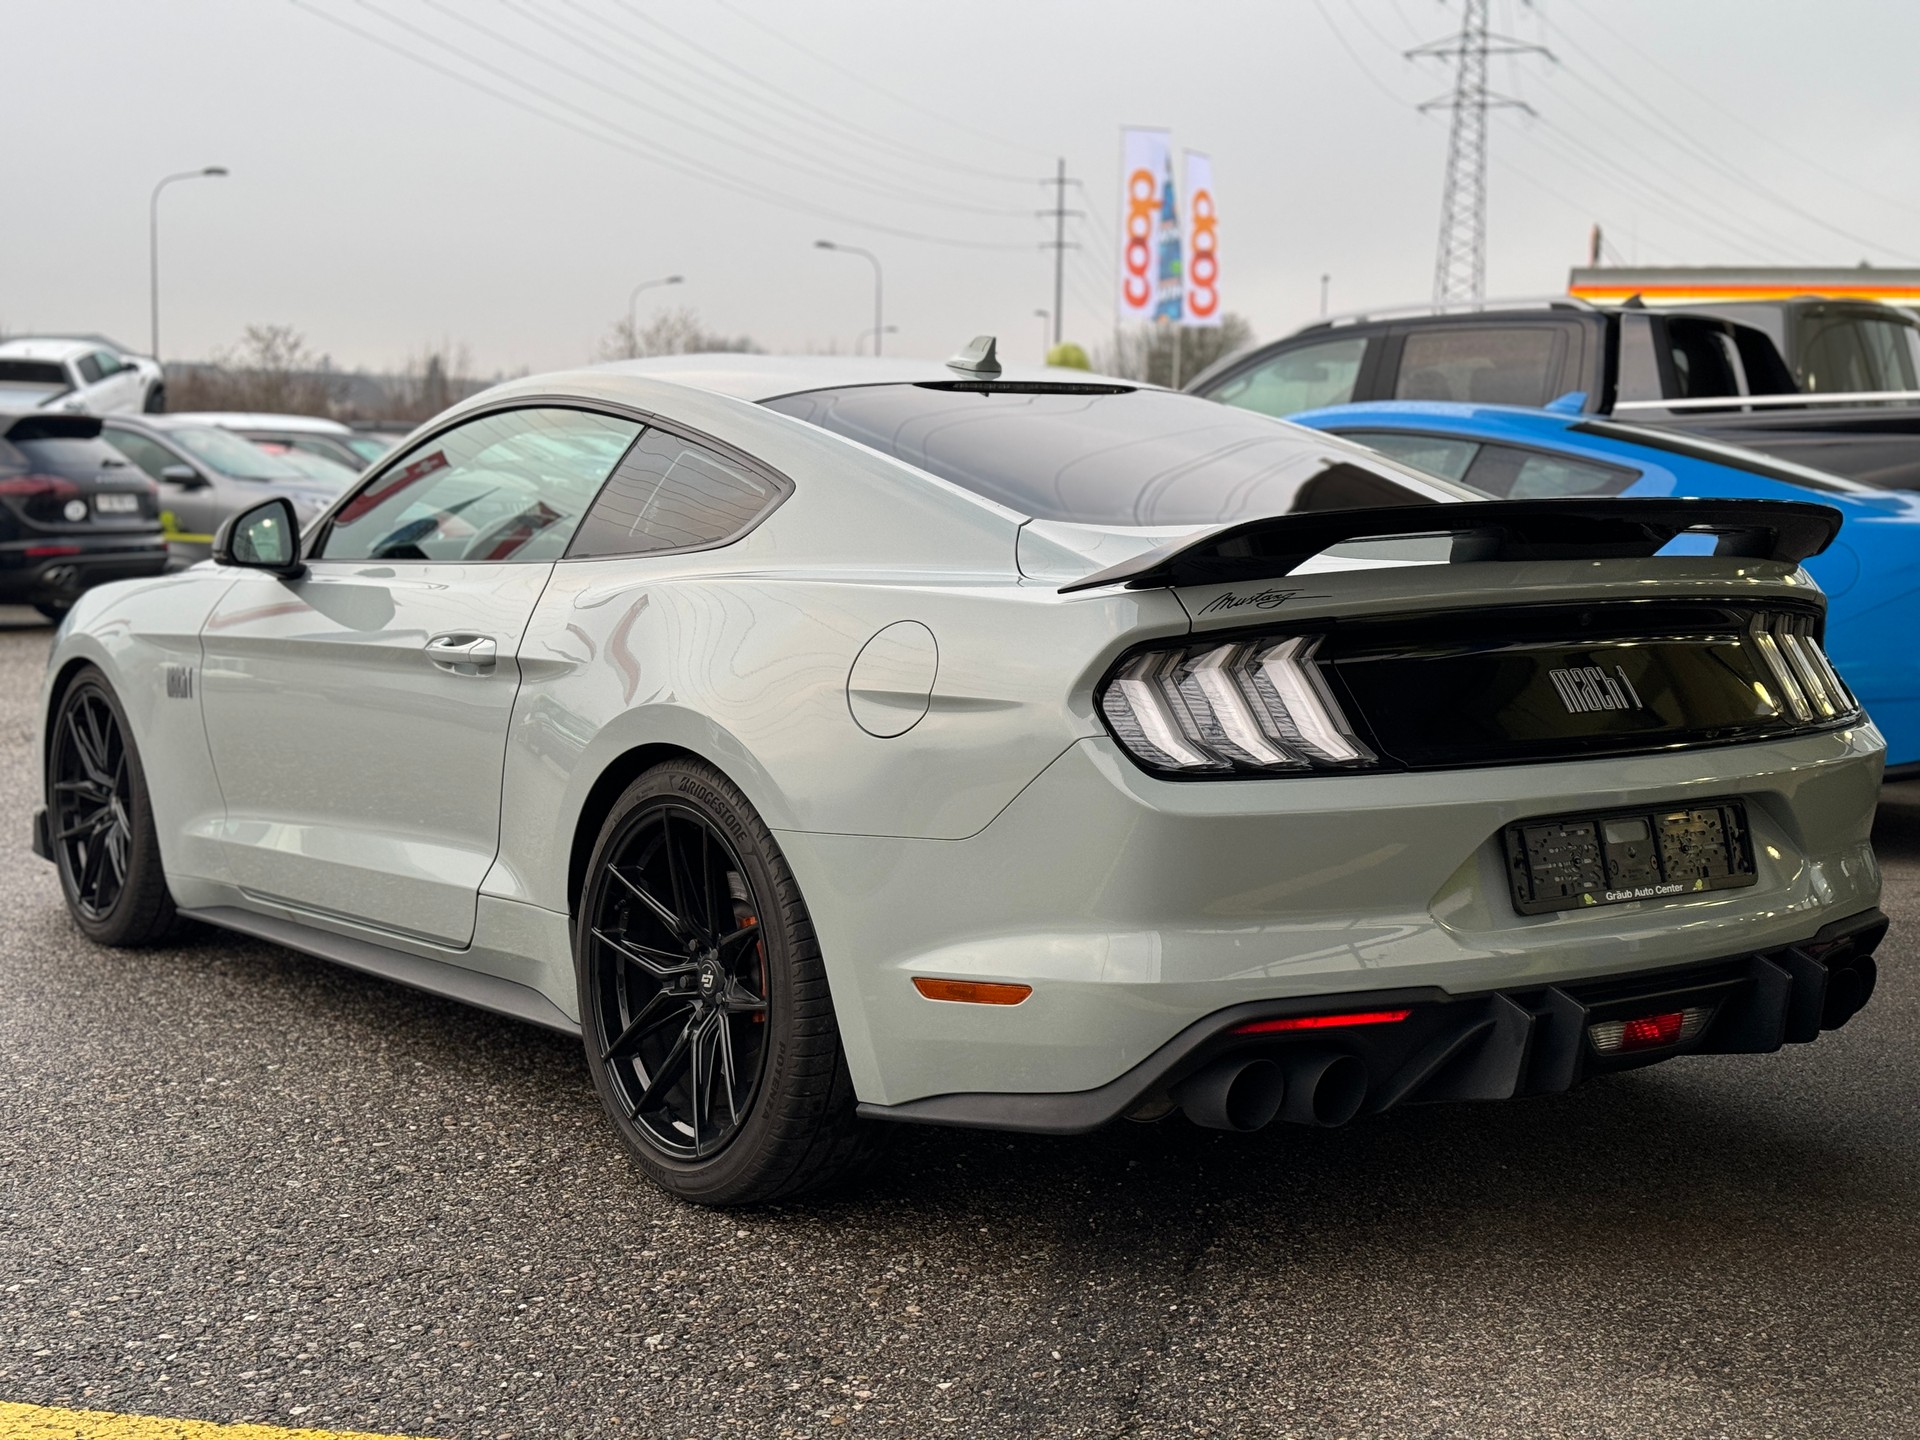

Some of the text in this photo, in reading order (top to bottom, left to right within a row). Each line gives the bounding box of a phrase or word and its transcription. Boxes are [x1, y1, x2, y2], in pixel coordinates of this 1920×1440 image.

[1124, 167, 1163, 308] coop
[1189, 188, 1219, 317] coop
[1197, 588, 1332, 616] Mustang
[1615, 665, 1643, 711] 1
[678, 776, 748, 843] BRIDGESTONE
[1605, 883, 1684, 901] Gräub Auto Center
[761, 1040, 786, 1120] POTENZA
